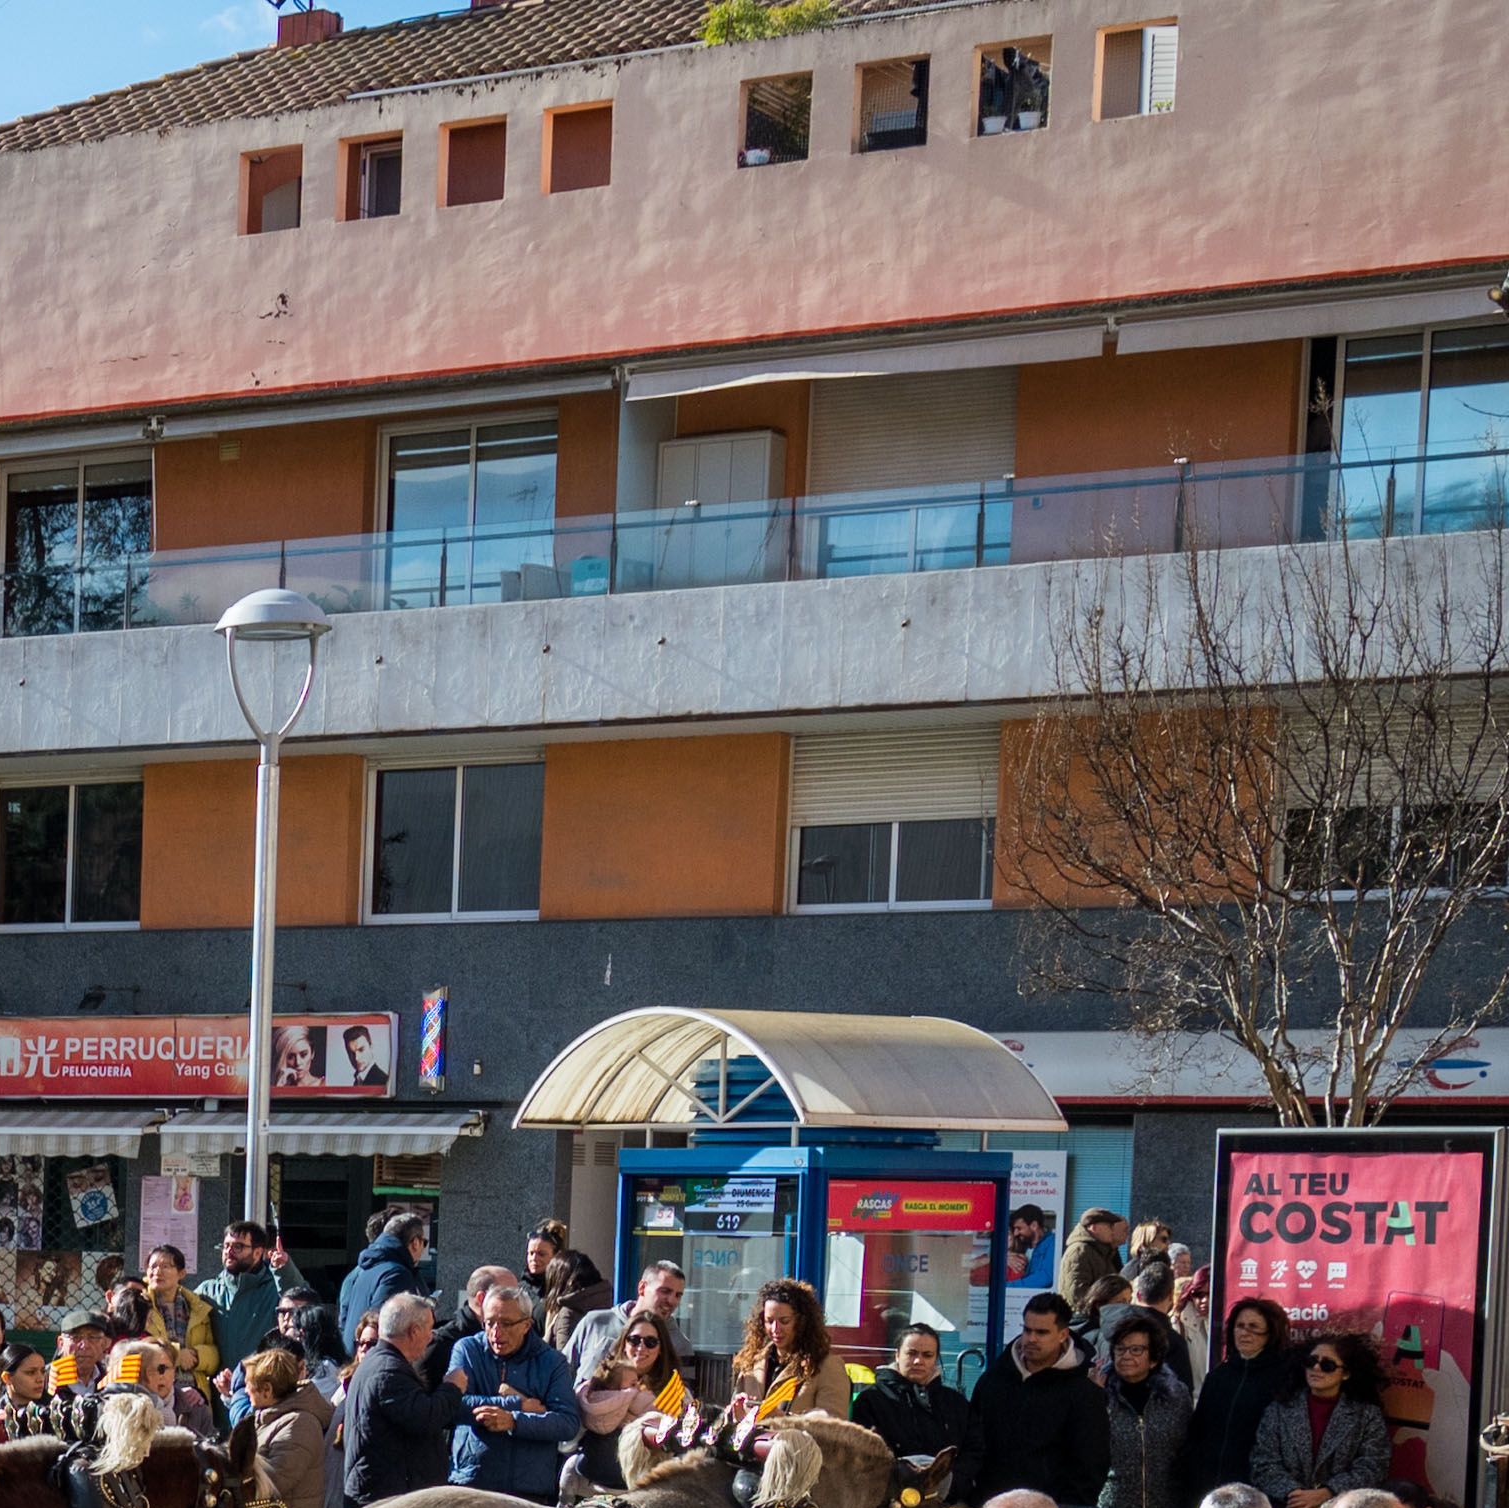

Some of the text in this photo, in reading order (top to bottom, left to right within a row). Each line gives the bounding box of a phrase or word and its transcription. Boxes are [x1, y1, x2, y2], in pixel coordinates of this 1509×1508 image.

[61, 1063, 132, 1078] PELUQUERÍA
[175, 1062, 210, 1079] Yang
[1244, 1173, 1350, 1196] AL TEU
[716, 1214, 741, 1230] 619
[1239, 1201, 1449, 1246] COSTAT
[884, 1254, 930, 1273] ONCE
